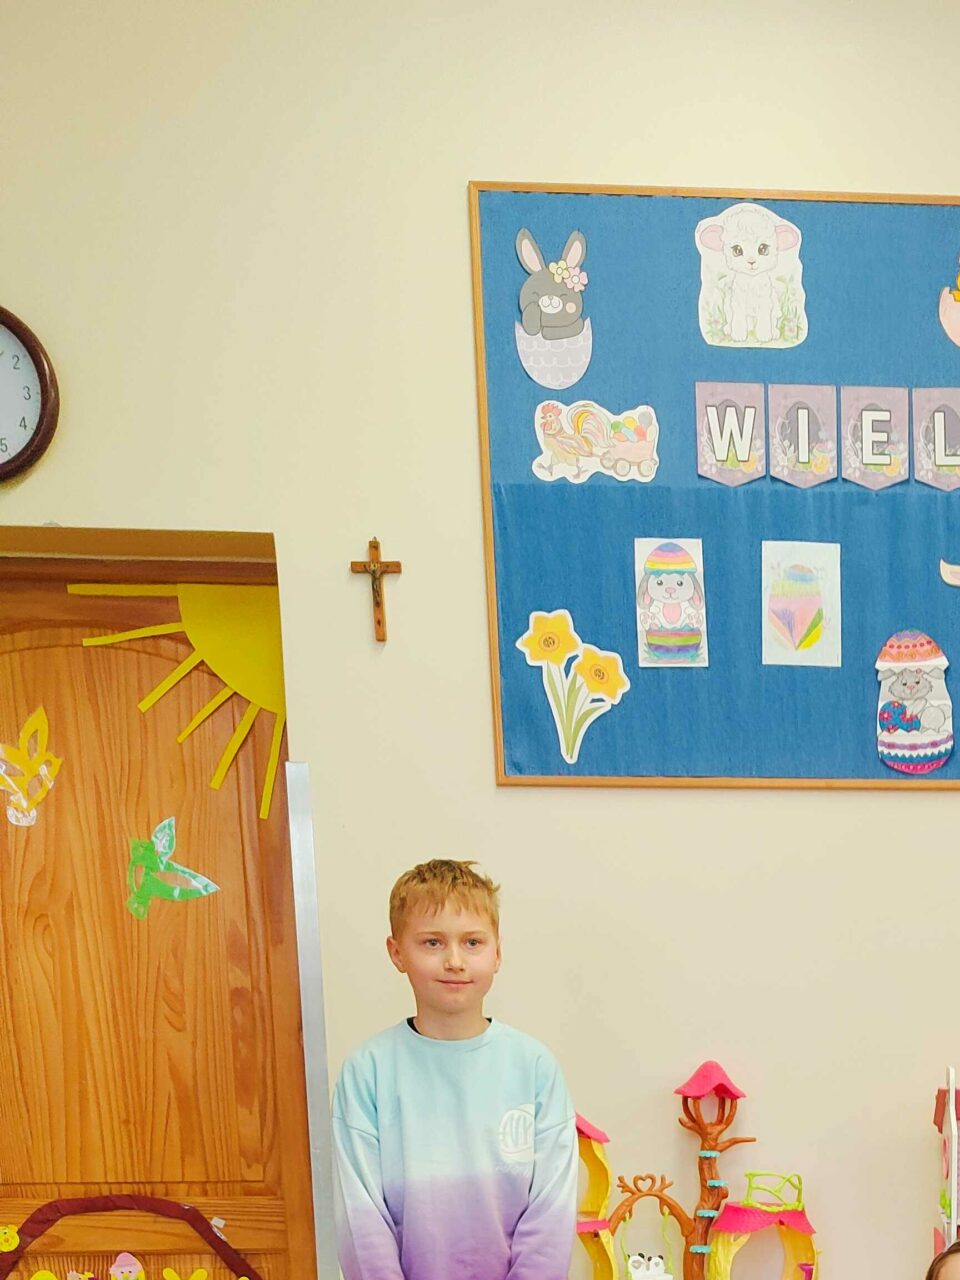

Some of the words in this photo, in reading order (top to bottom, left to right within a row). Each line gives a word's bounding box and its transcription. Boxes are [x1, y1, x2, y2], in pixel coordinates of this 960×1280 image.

[12, 354, 20, 370] 2
[23, 385, 31, 400] 3
[19, 416, 27, 430] 4
[0, 438, 8, 453] 5
